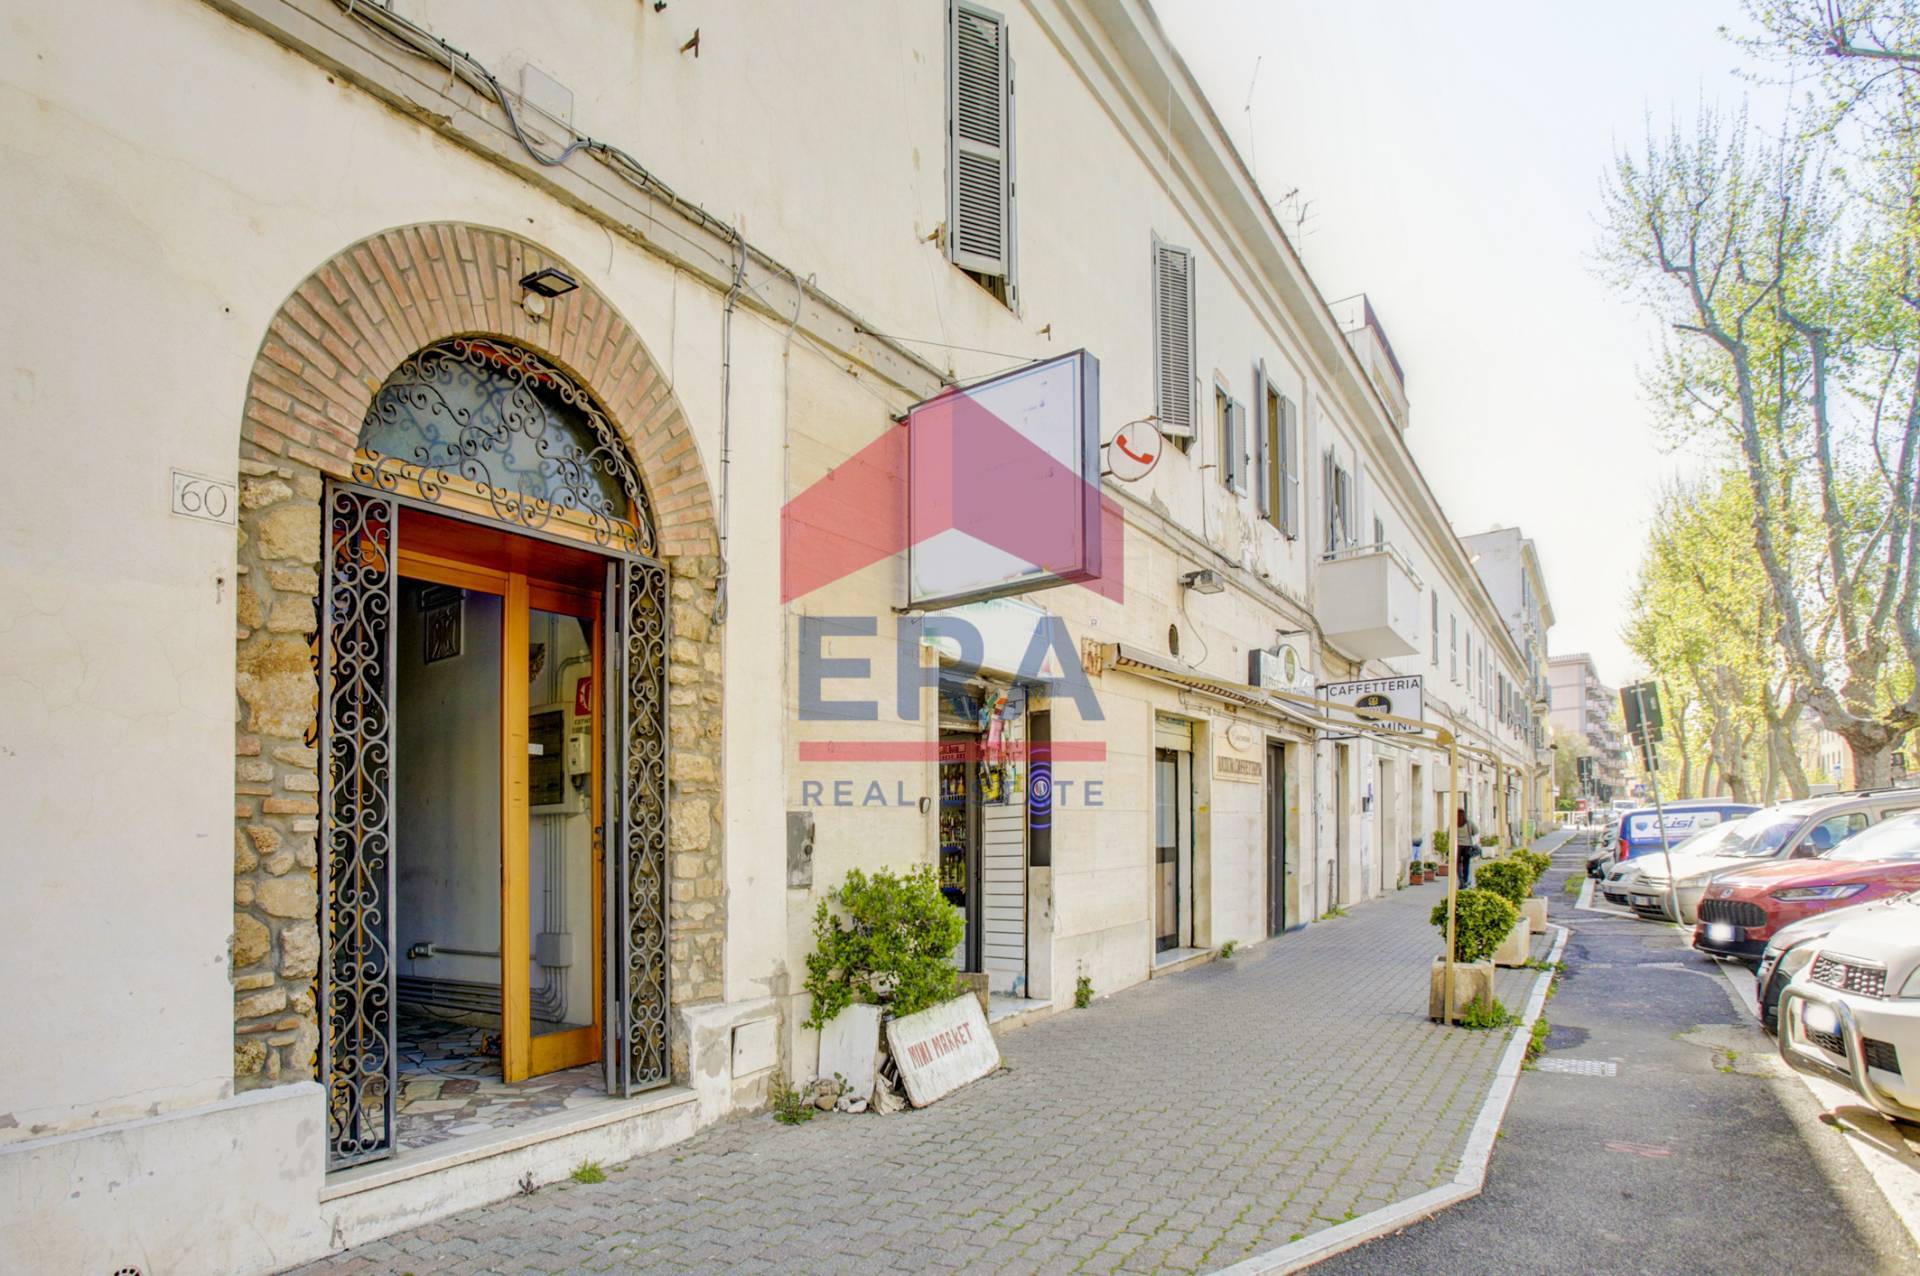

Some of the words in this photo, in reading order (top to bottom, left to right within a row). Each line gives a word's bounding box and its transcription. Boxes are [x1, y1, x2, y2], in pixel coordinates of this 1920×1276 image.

[181, 480, 227, 518] 60
[1329, 679, 1420, 697] CAFFETTERIA
[907, 1040, 933, 1070] MINI
[931, 1022, 973, 1058] MARKET
